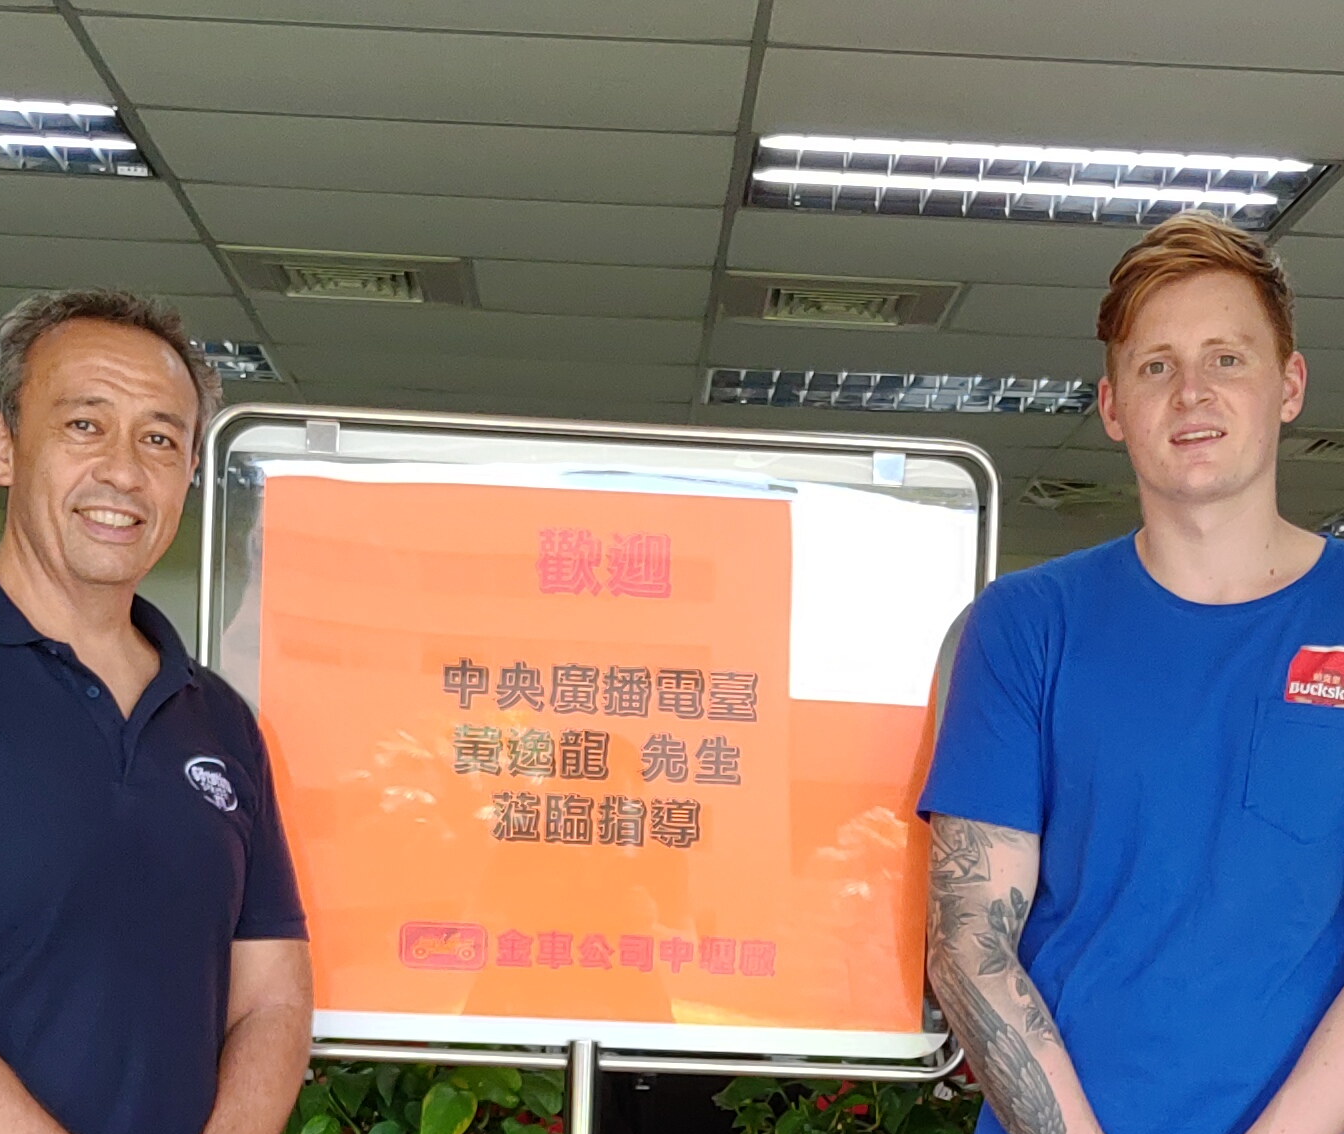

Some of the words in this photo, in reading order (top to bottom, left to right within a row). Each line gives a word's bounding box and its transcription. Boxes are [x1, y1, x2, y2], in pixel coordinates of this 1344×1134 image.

[537, 527, 672, 598] 歡迎
[442, 657, 758, 722] 中央廣播電臺
[451, 723, 609, 780] 黃逸龍
[641, 733, 741, 785] 先生
[491, 791, 701, 849] 蒞臨指導
